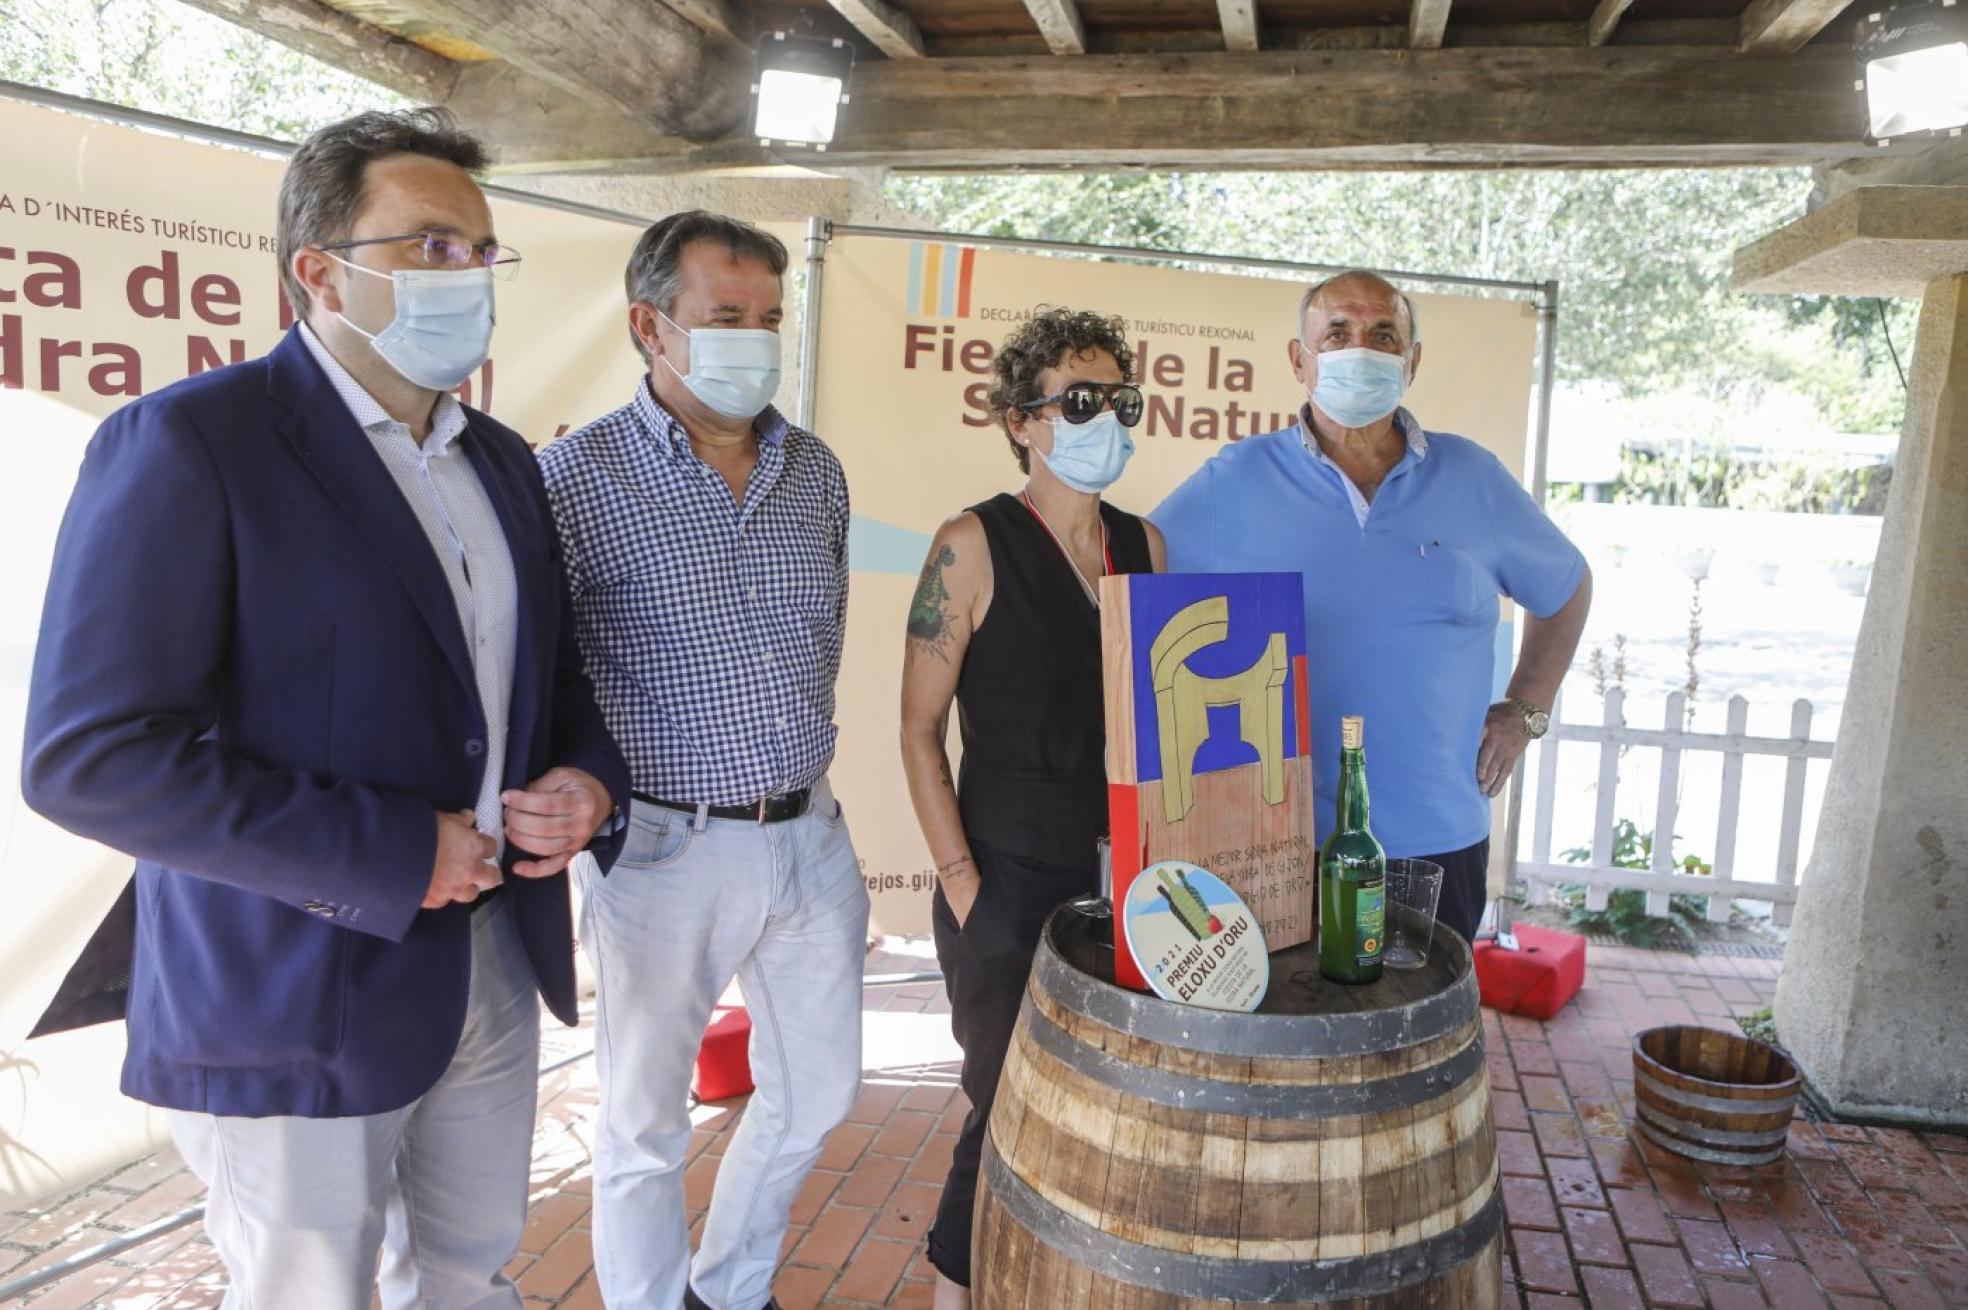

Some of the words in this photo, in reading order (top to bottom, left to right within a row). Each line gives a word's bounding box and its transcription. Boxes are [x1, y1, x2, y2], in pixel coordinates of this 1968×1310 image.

[151, 218, 251, 250] TURÍSTICU
[126, 250, 241, 326] de
[904, 324, 995, 375] Fie
[1135, 318, 1196, 337] TURÍSTICU
[1199, 325, 1255, 342] REXONAL
[1207, 346, 1254, 392] la
[1146, 394, 1299, 441] Natu
[1155, 943, 1182, 973] 2021
[1167, 944, 1204, 987] PREMIU
[1178, 954, 1217, 1002] ELOXU
[1213, 916, 1248, 958] D'ORU
